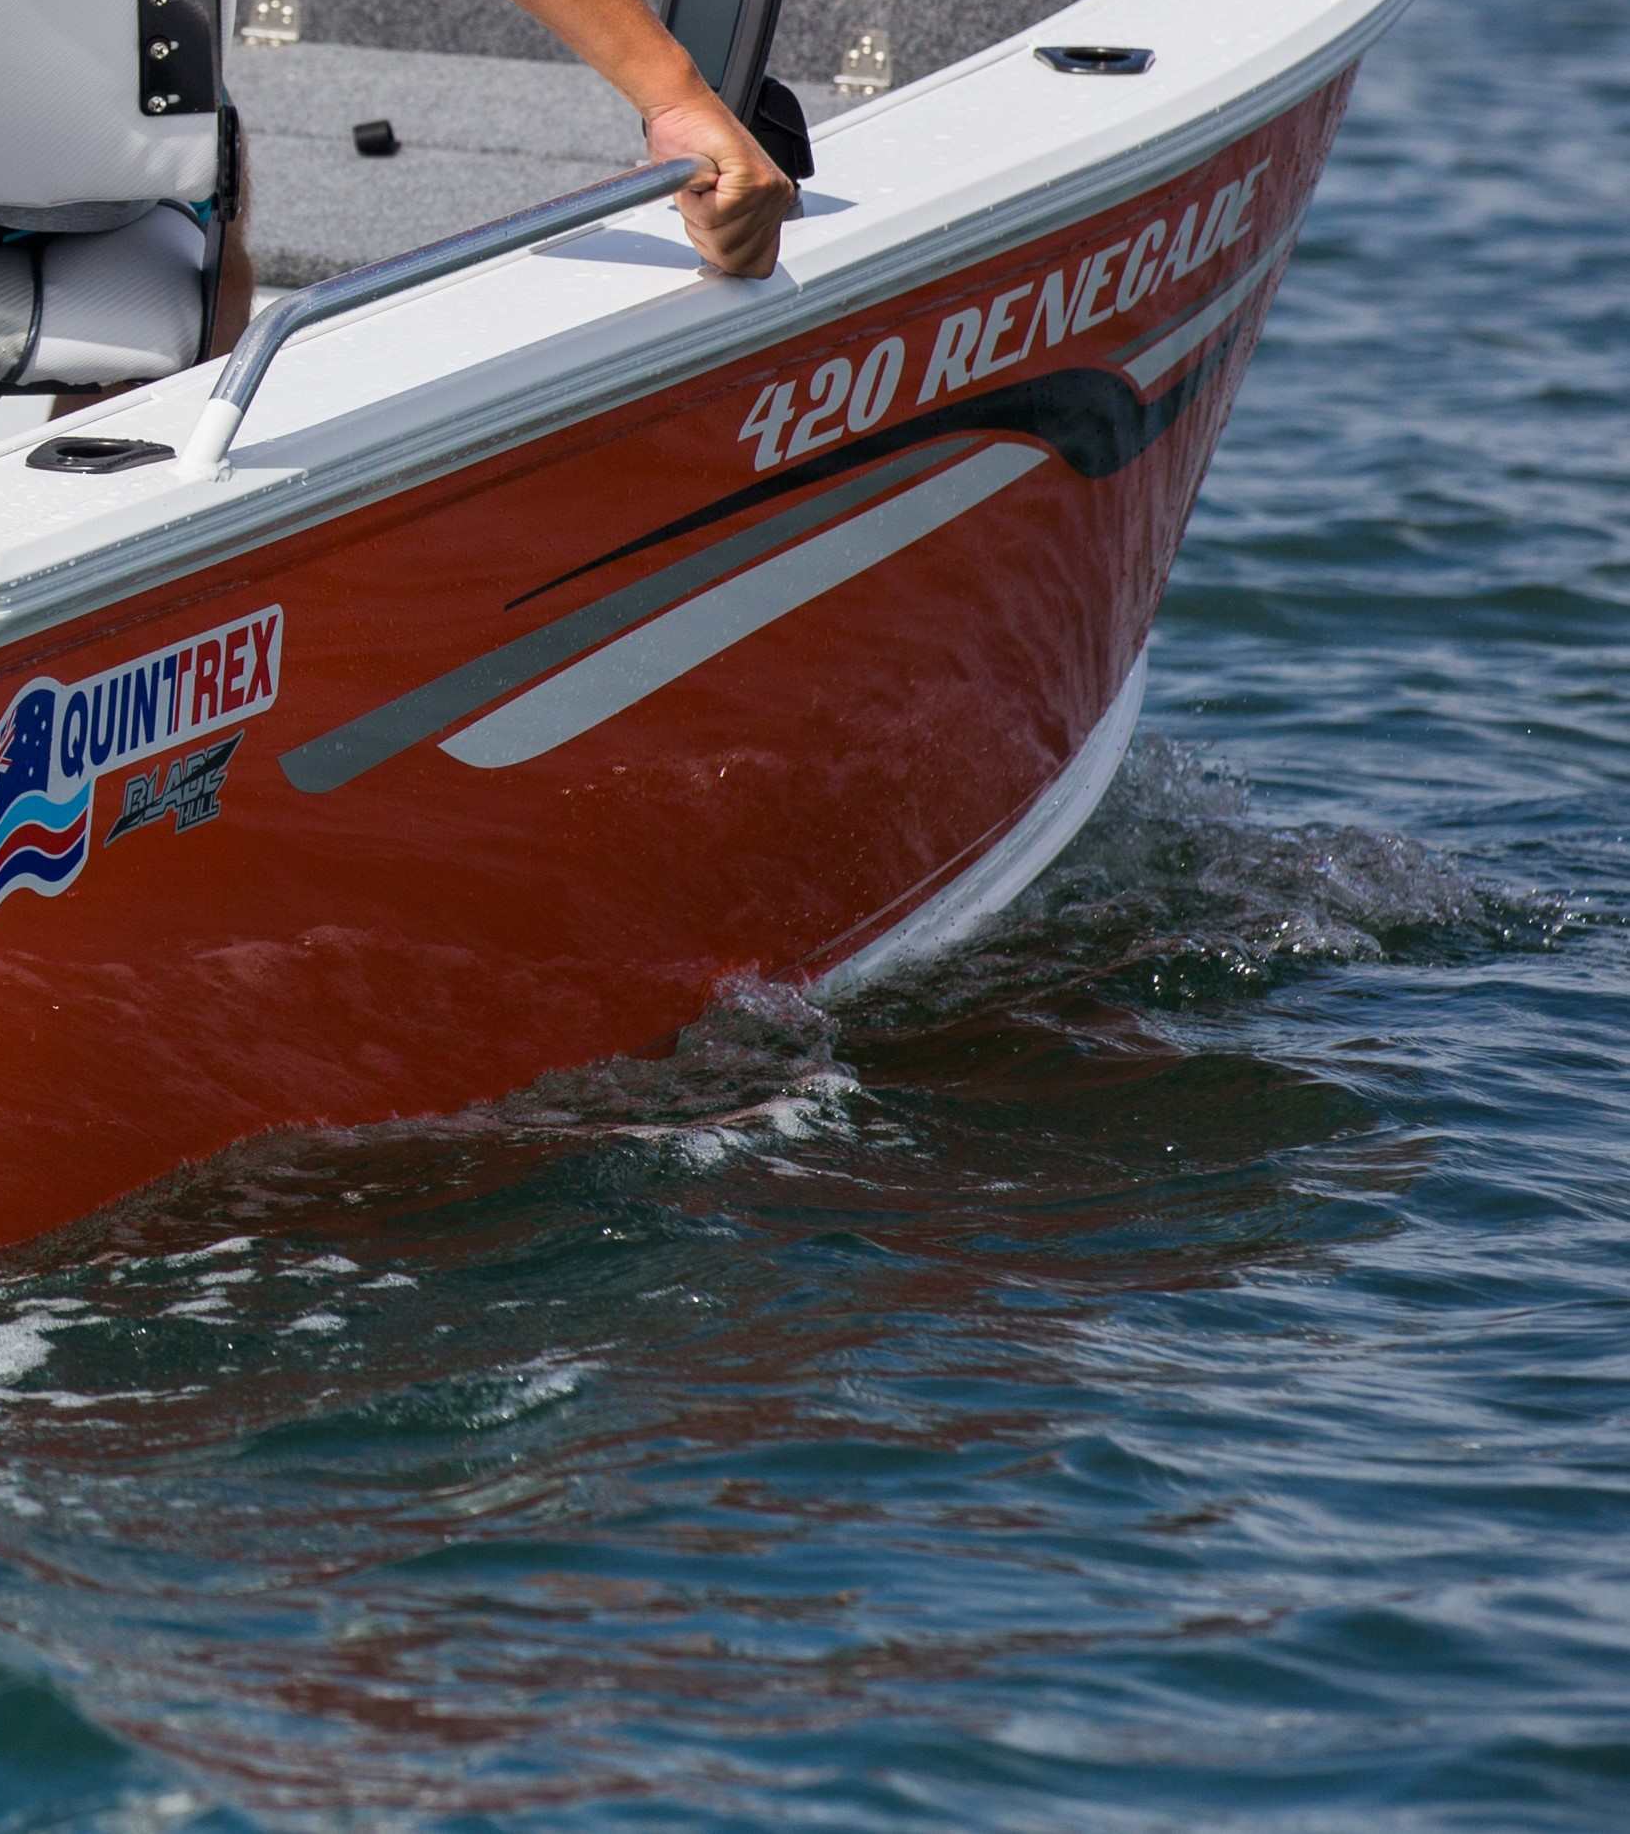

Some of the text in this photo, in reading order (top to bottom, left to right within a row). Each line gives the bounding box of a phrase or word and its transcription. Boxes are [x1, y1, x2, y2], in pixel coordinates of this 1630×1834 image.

[738, 157, 1273, 472] 420 RENEGADE
[60, 613, 279, 780] QUINTREX
[111, 732, 243, 834] BLADE
[177, 794, 220, 831] HULL
